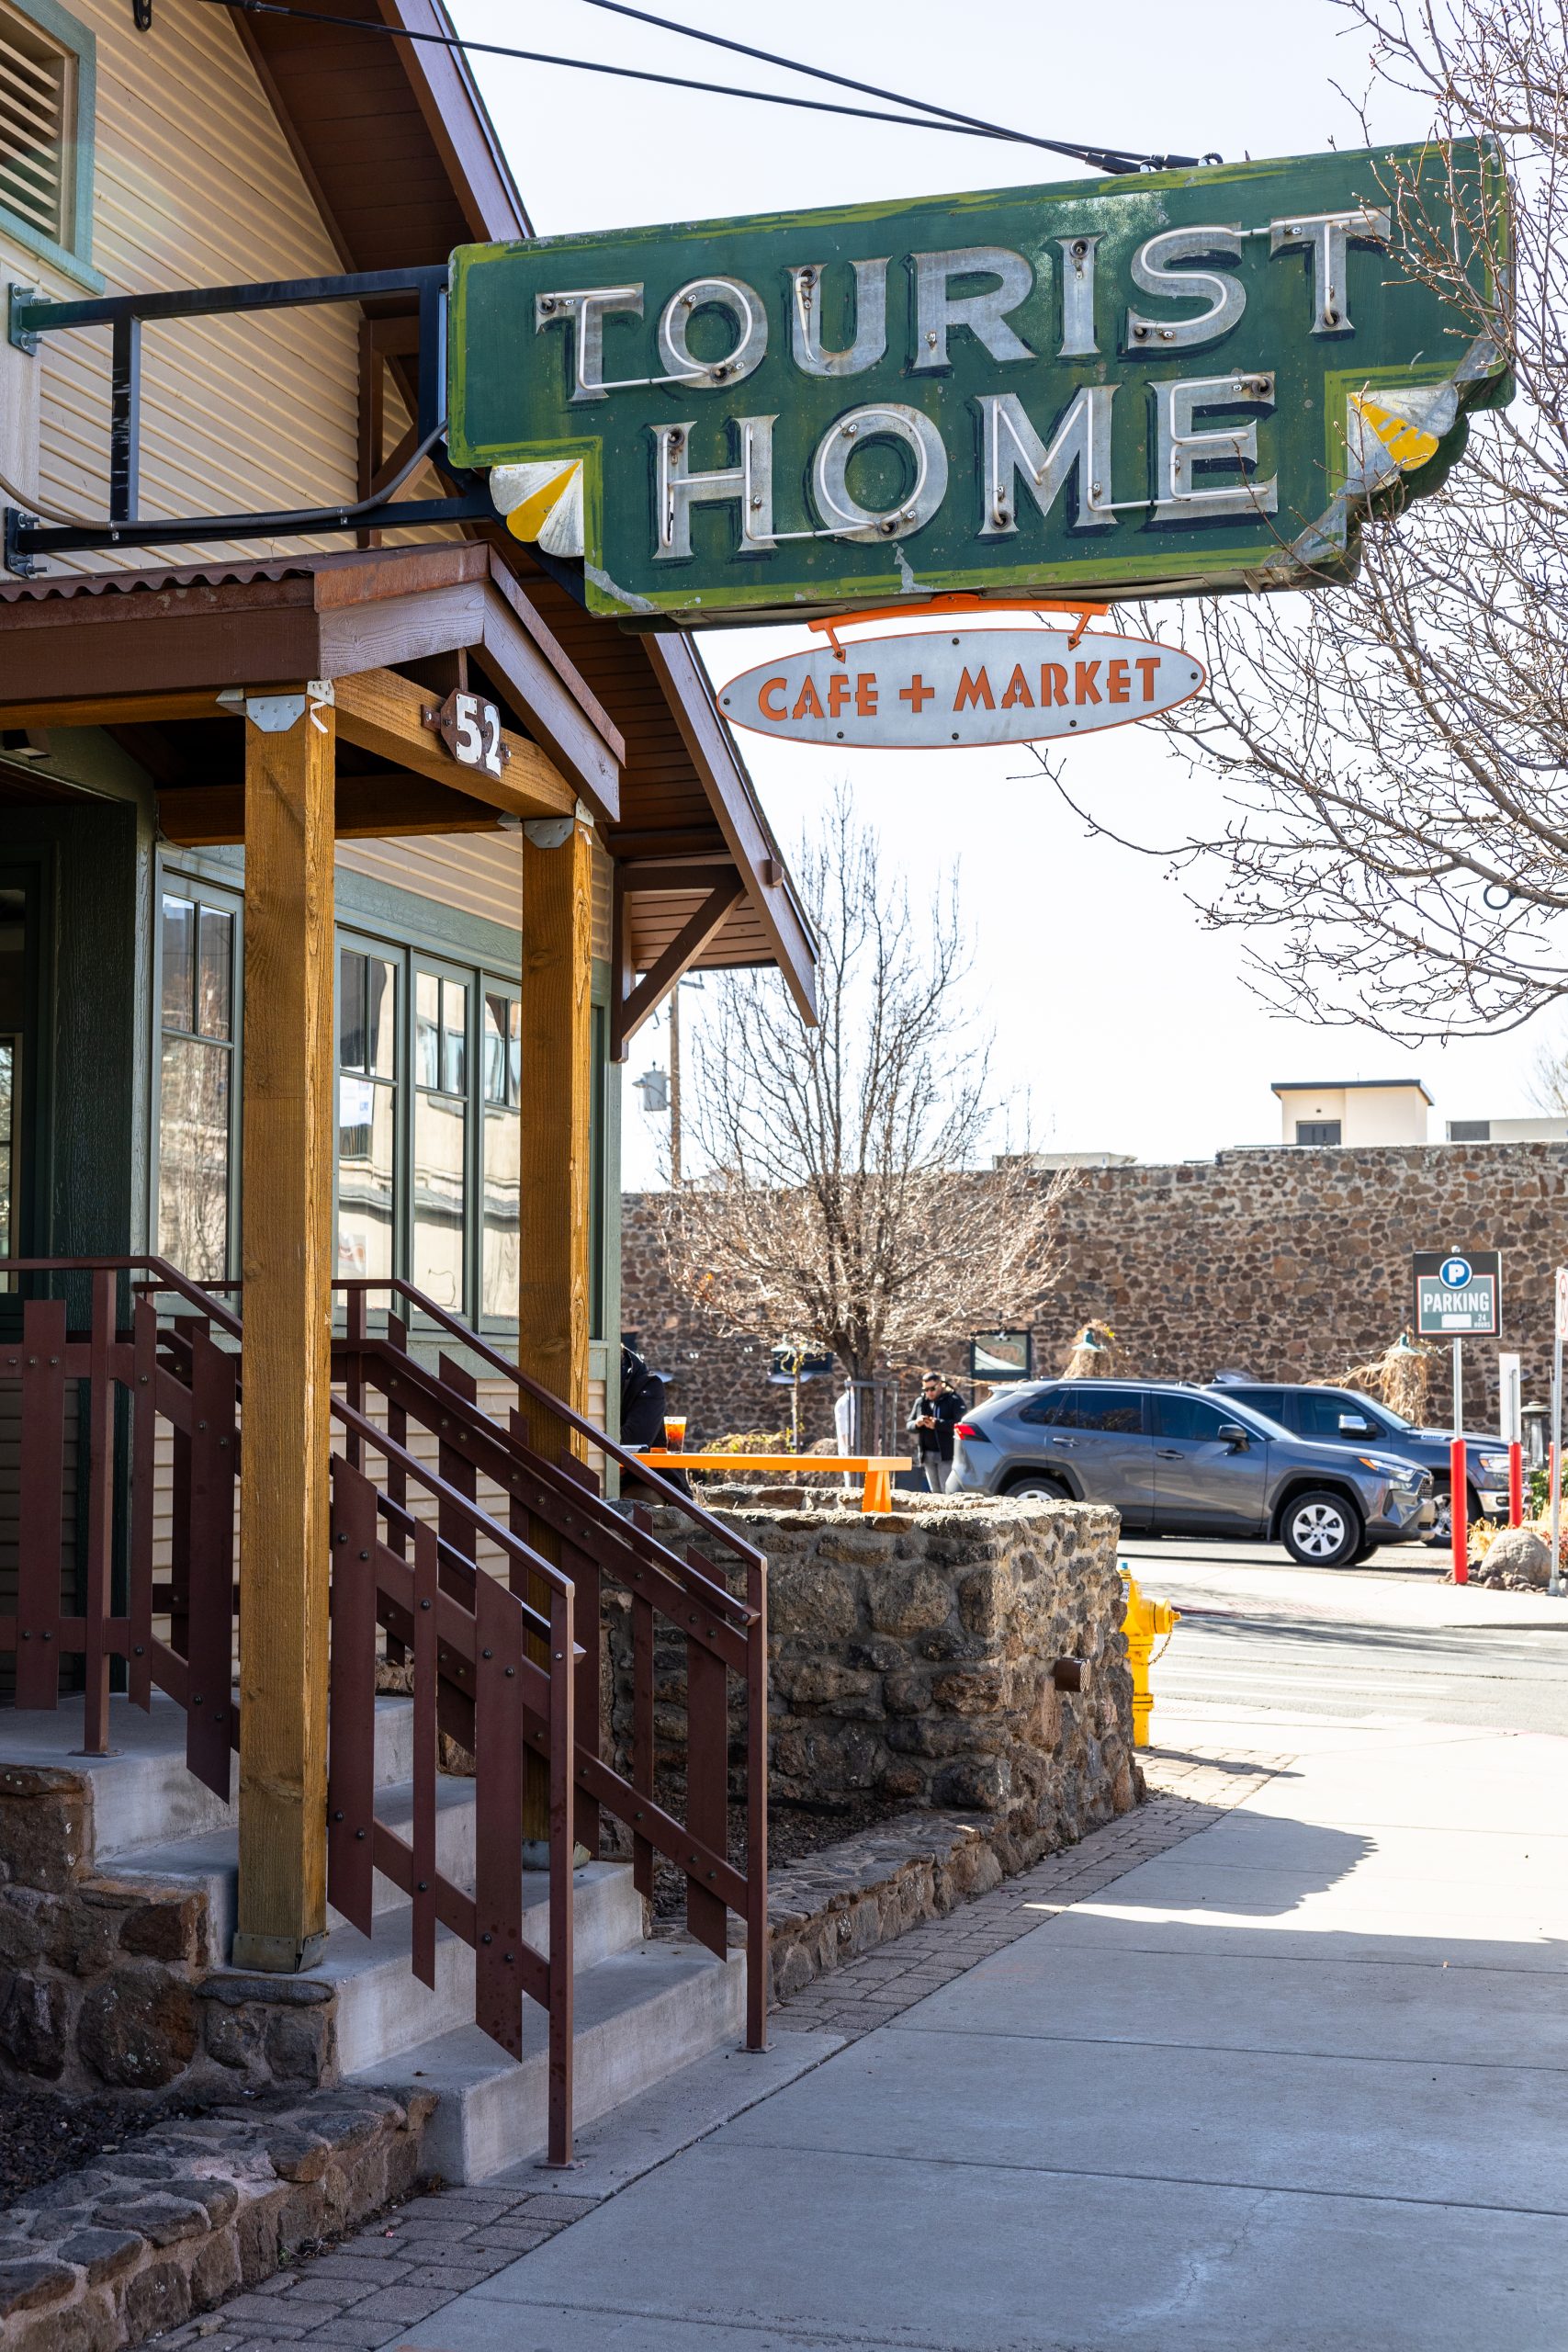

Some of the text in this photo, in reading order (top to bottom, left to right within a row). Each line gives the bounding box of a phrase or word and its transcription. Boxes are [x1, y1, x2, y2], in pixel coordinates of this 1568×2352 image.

[535, 206, 1392, 401] TOURIST
[649, 370, 1278, 559] HOME
[758, 672, 878, 721] CAFE
[953, 657, 1161, 711] MARKET
[456, 693, 502, 777] 52
[1423, 1292, 1489, 1312] PARKING
[1449, 1264, 1465, 1283] P
